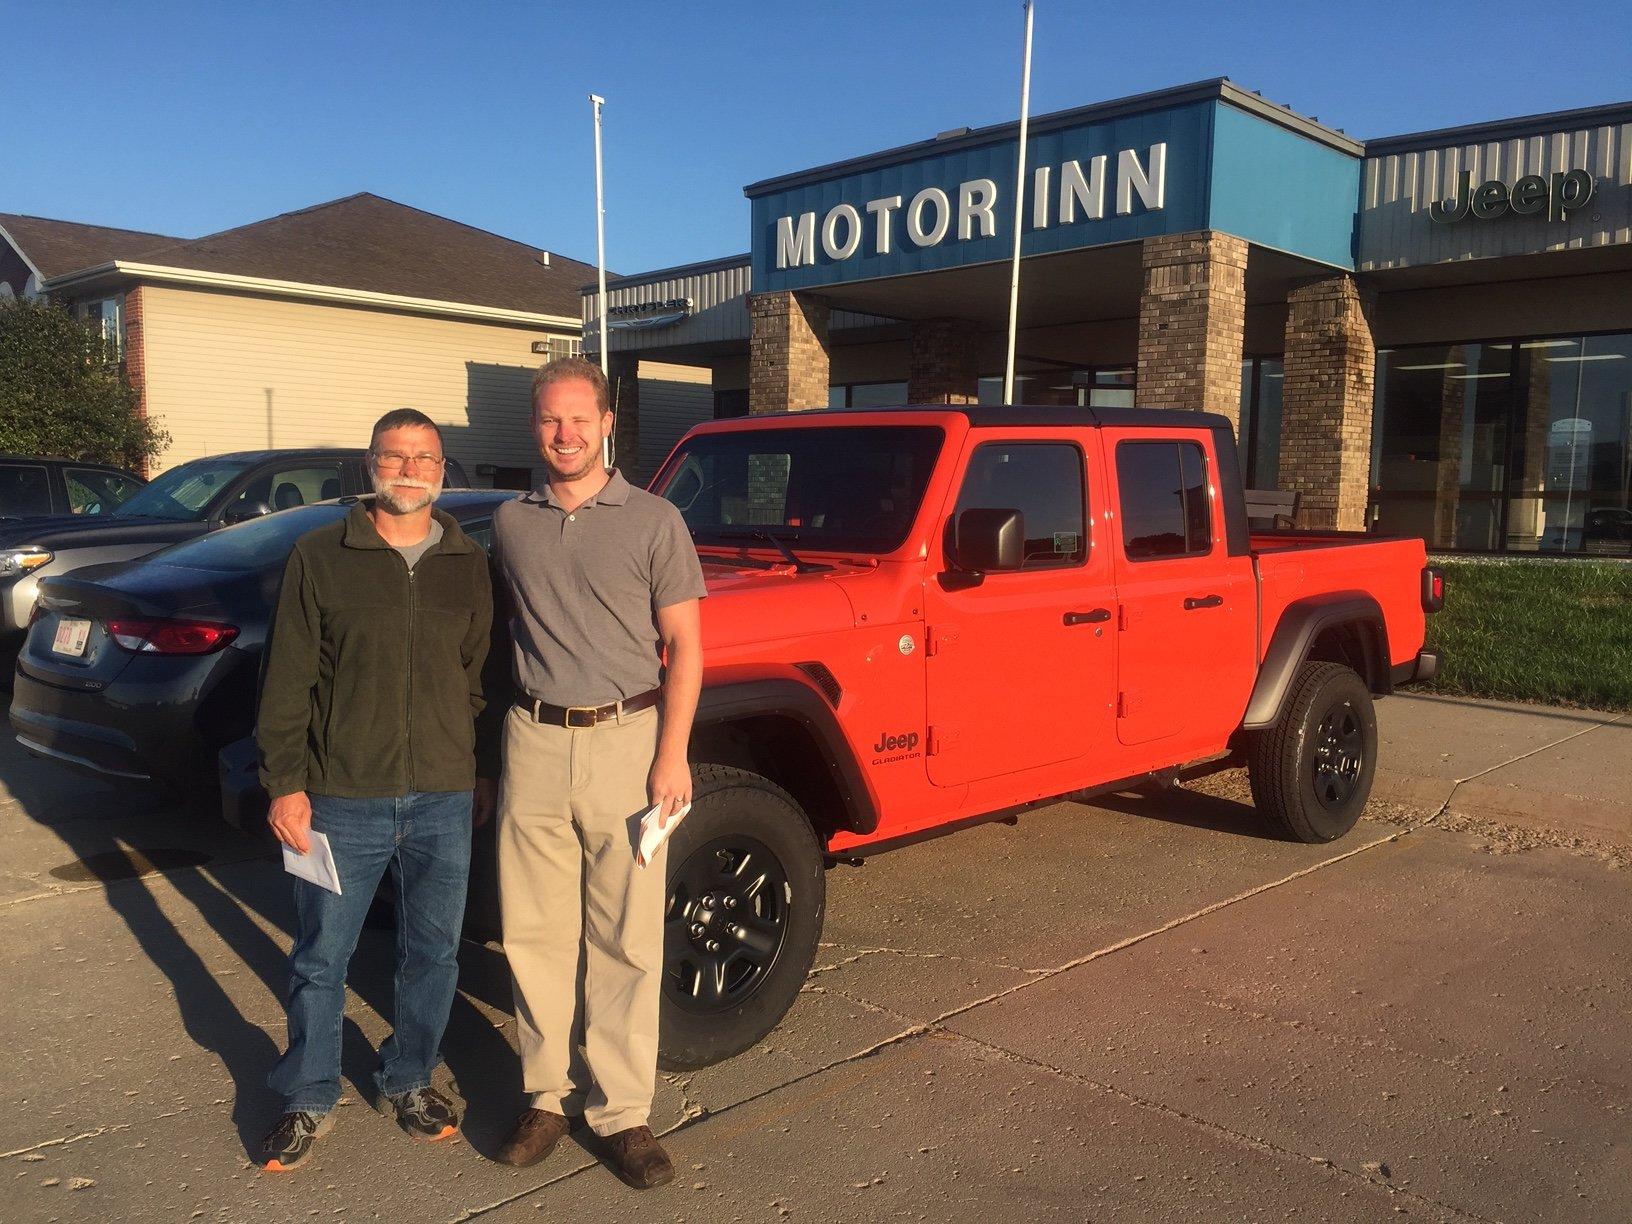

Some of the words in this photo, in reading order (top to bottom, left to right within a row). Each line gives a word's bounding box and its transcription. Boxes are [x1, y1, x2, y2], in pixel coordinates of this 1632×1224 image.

[776, 178, 998, 269] MOTOR
[1033, 142, 1167, 229] INN
[1429, 168, 1594, 224] Jeep
[871, 752, 921, 766] GLADIATOR
[873, 731, 919, 753] Jeep
